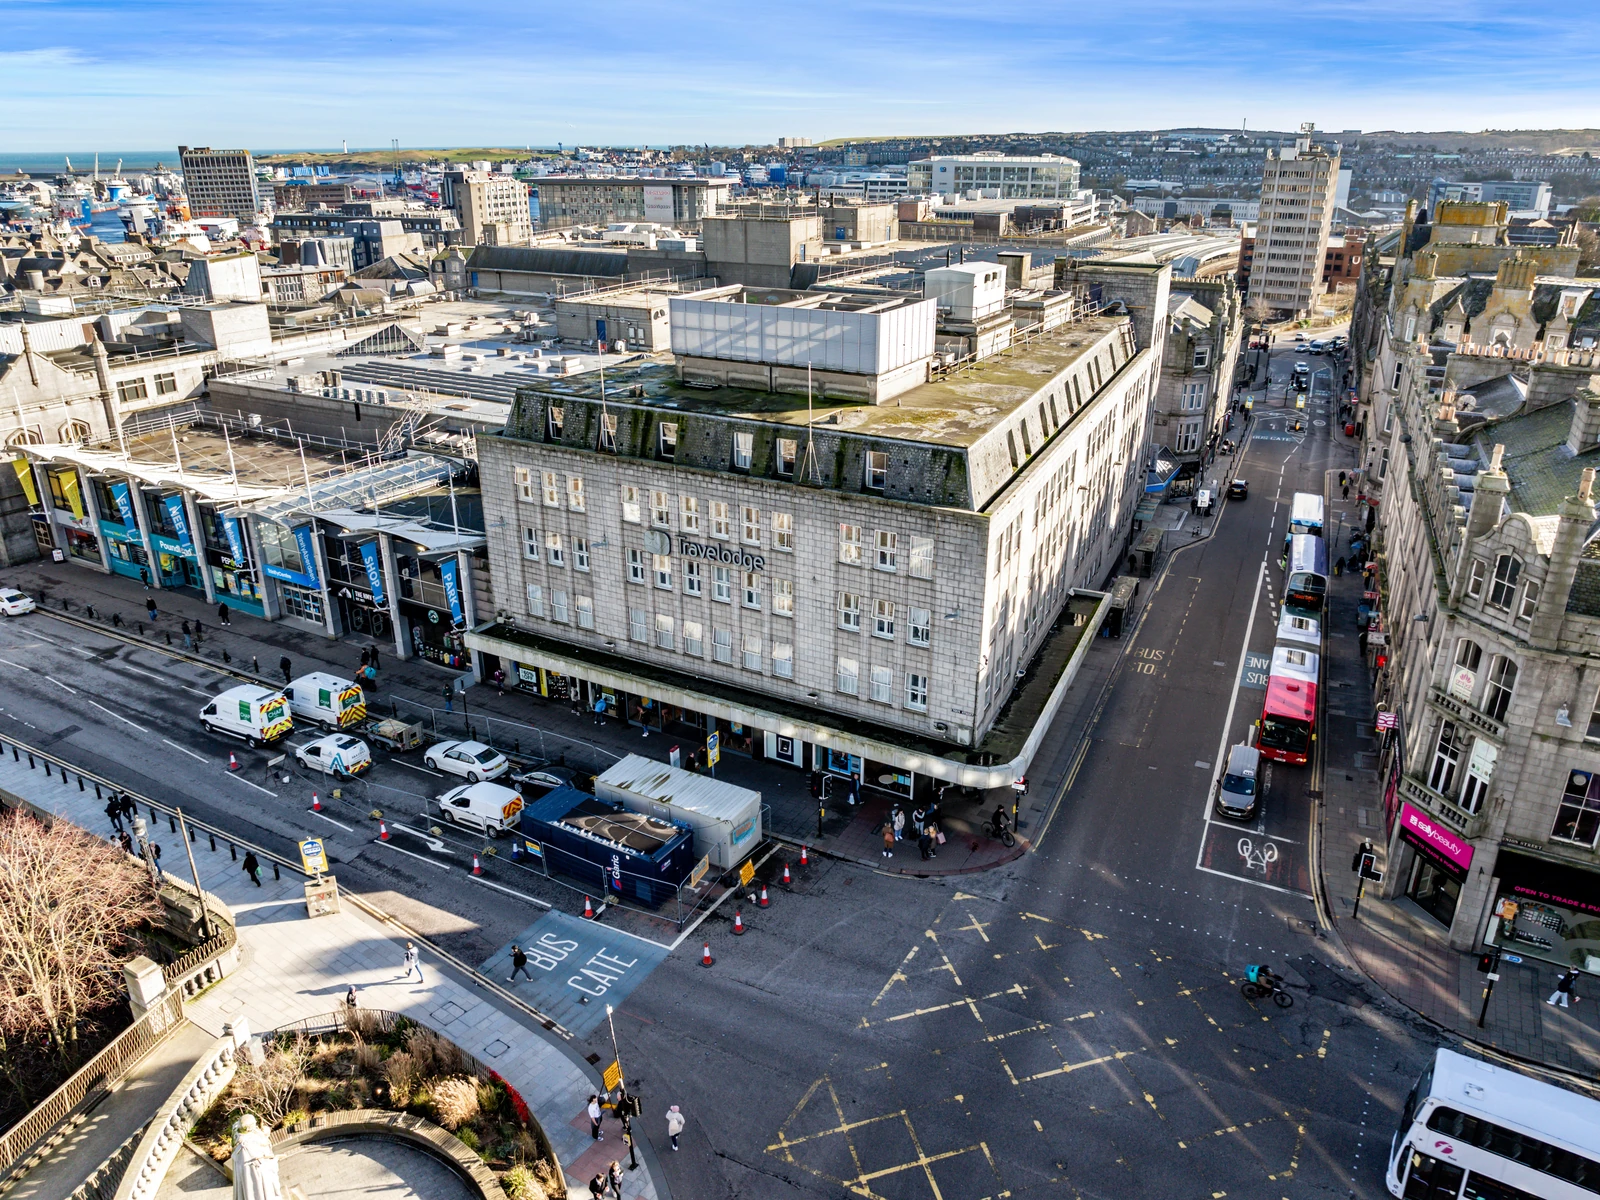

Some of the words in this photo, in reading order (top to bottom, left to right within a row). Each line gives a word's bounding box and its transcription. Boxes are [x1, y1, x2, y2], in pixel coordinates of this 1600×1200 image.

[118, 497, 132, 519] EAT
[168, 505, 187, 535] MEET
[297, 532, 316, 582] TrinityAberdeen
[677, 534, 765, 573] Travelodge
[364, 555, 381, 588] SHOP
[443, 572, 460, 607] PARK
[1133, 647, 1166, 660] BUS
[1245, 655, 1270, 670] ANE
[1246, 671, 1269, 686] BUS
[240, 711, 251, 719] CHAP
[267, 708, 283, 718] CHAP
[1406, 834, 1419, 845] OPEN
[1425, 847, 1440, 859] TRADE
[1520, 841, 1542, 850] STREET
[612, 854, 621, 879] Garic
[1514, 885, 1537, 896] OPEN
[1539, 891, 1550, 899] TO
[1552, 894, 1579, 907] TRADE
[524, 932, 579, 972] BUS
[567, 947, 638, 997] GATE
